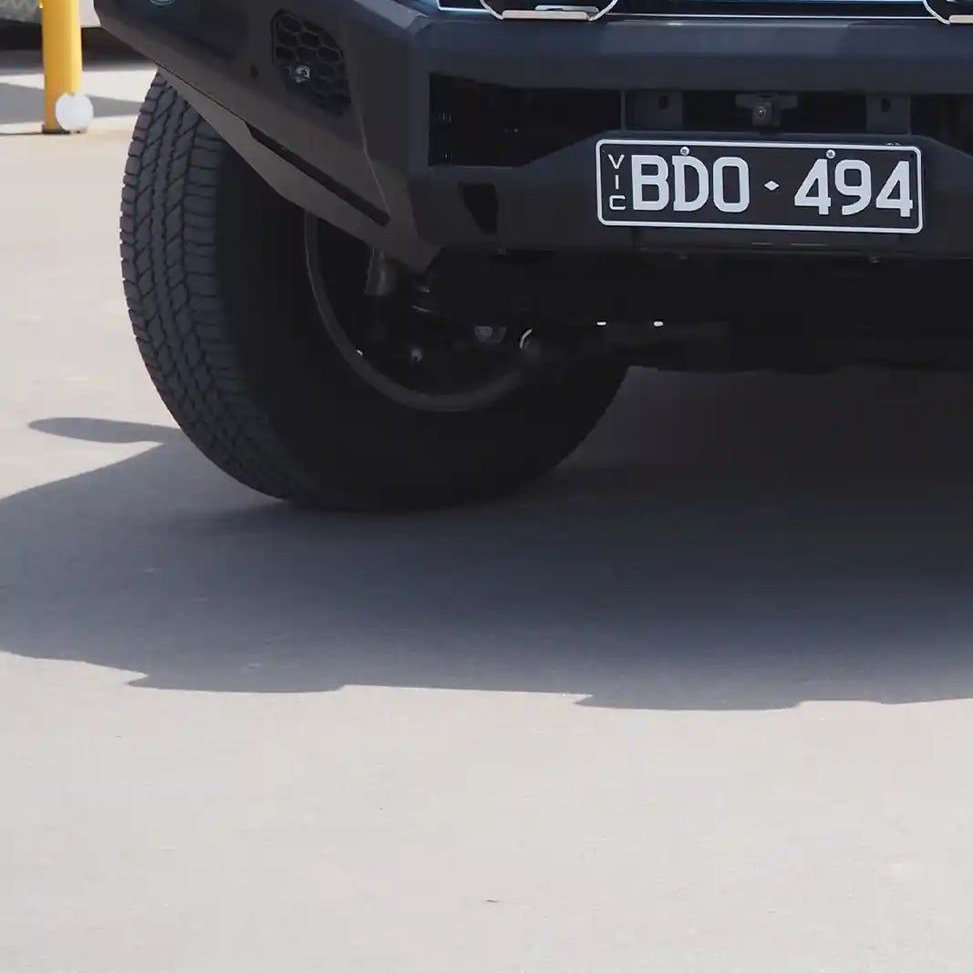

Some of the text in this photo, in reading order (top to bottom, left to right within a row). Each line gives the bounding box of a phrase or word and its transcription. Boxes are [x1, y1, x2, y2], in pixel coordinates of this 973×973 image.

[608, 153, 626, 211] VIC
[631, 154, 914, 218] BDO 494
